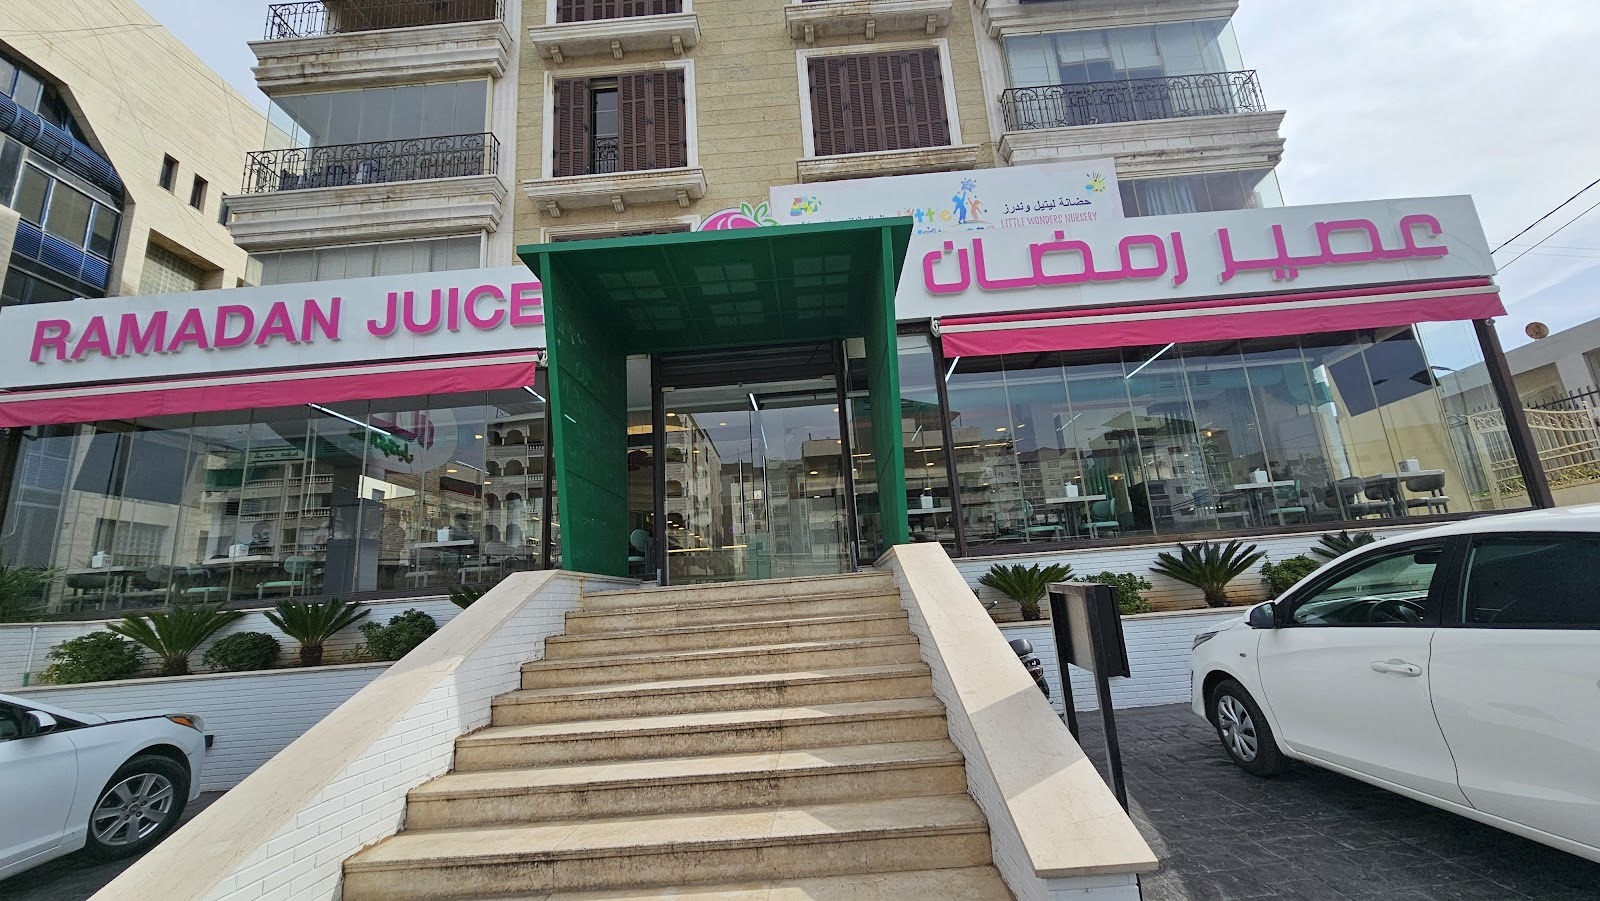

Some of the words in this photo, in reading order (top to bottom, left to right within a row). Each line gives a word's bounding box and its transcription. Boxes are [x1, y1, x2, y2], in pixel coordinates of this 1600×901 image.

[1002, 201, 1031, 214] وندرز
[1034, 199, 1056, 211] ليتيل
[1059, 197, 1092, 207] حضانة
[1000, 217, 1025, 229] LITTLE
[1027, 214, 1063, 226] WONDERS
[1064, 211, 1098, 223] NURSERY
[1218, 214, 1449, 283] عصير
[922, 230, 1188, 294] رمضان
[29, 297, 341, 363] RAMADAN
[367, 281, 544, 337] JUICE
